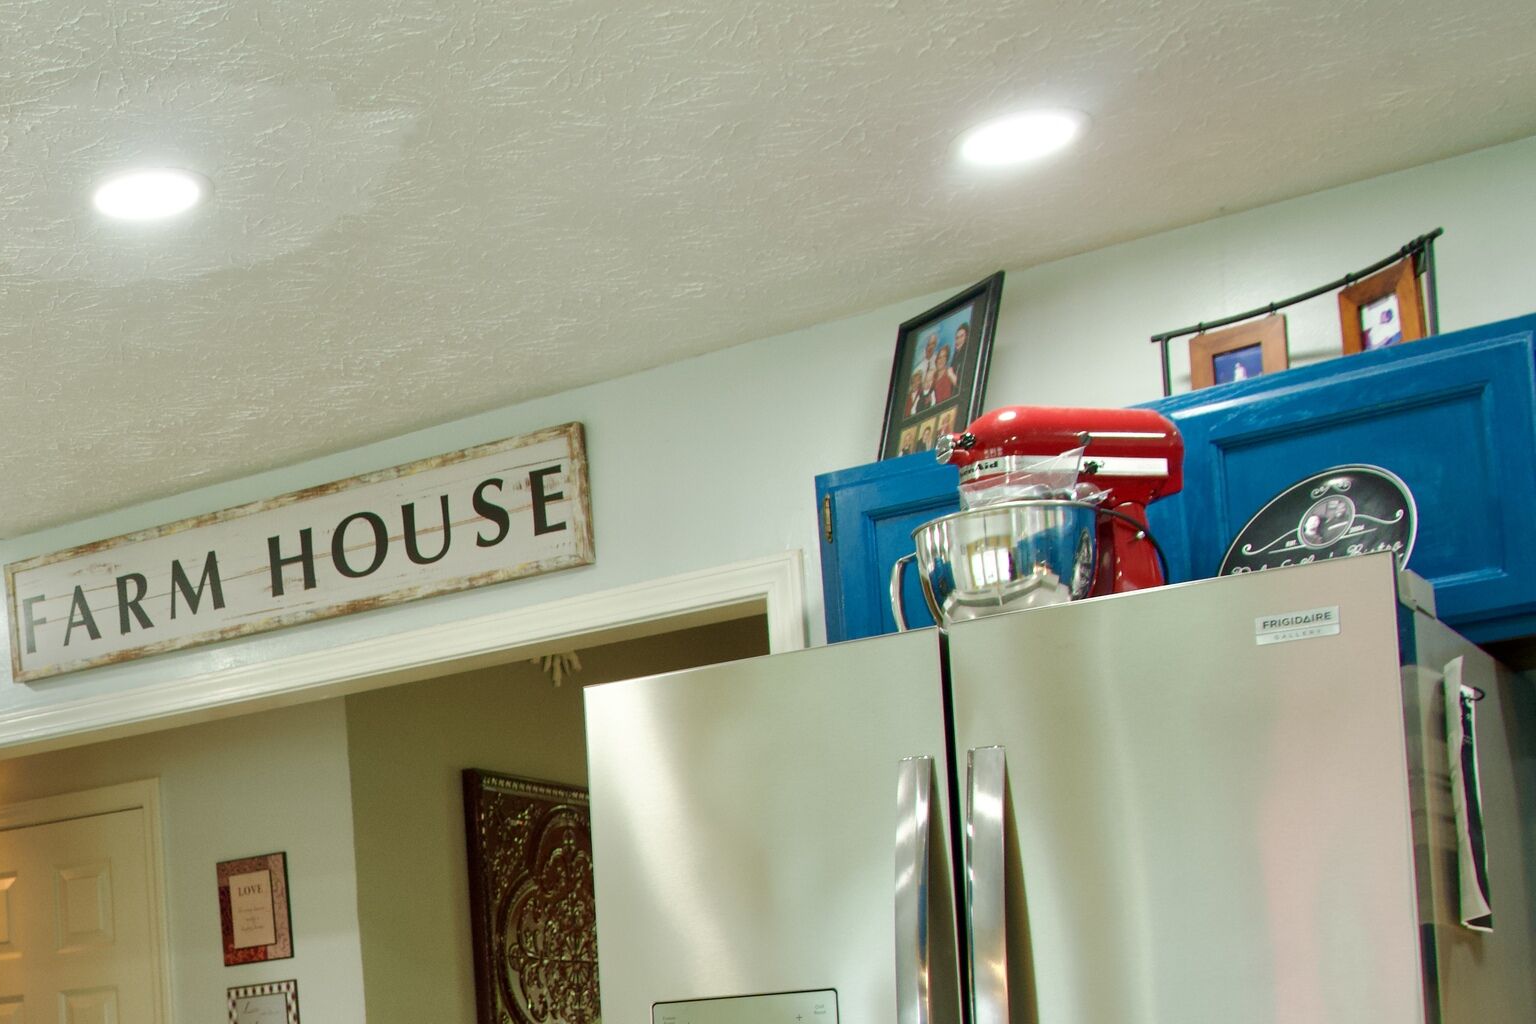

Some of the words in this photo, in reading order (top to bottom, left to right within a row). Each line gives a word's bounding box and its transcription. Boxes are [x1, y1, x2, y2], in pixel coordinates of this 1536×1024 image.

[20, 549, 226, 655] FARM
[266, 463, 567, 597] HOUSE
[1263, 611, 1332, 629] FRIGIDAIRE
[237, 883, 264, 897] LOVE
